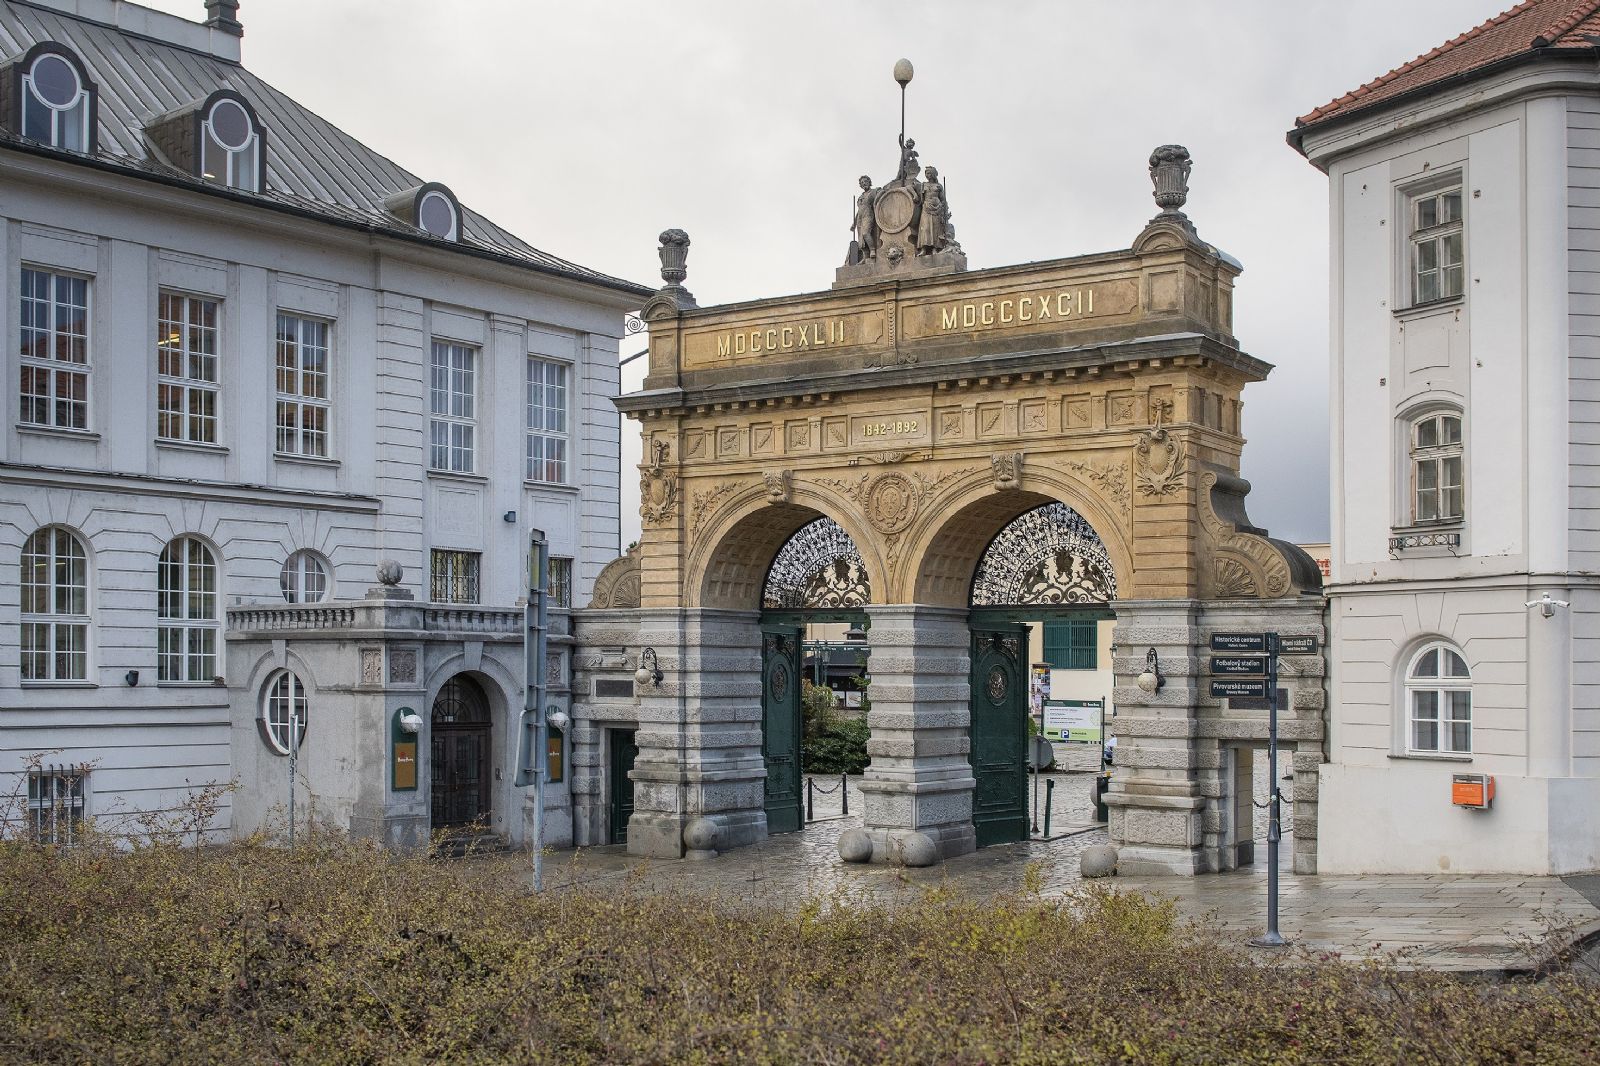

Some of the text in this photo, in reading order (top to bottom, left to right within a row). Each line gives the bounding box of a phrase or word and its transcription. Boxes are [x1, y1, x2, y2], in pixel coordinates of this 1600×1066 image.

[942, 289, 1093, 330] MDCCCXCII
[717, 320, 844, 357] MDCCCXLII
[863, 420, 917, 436] 1842-1892
[1216, 659, 1241, 667] Fotbalový
[1213, 682, 1241, 690] Pivovarské
